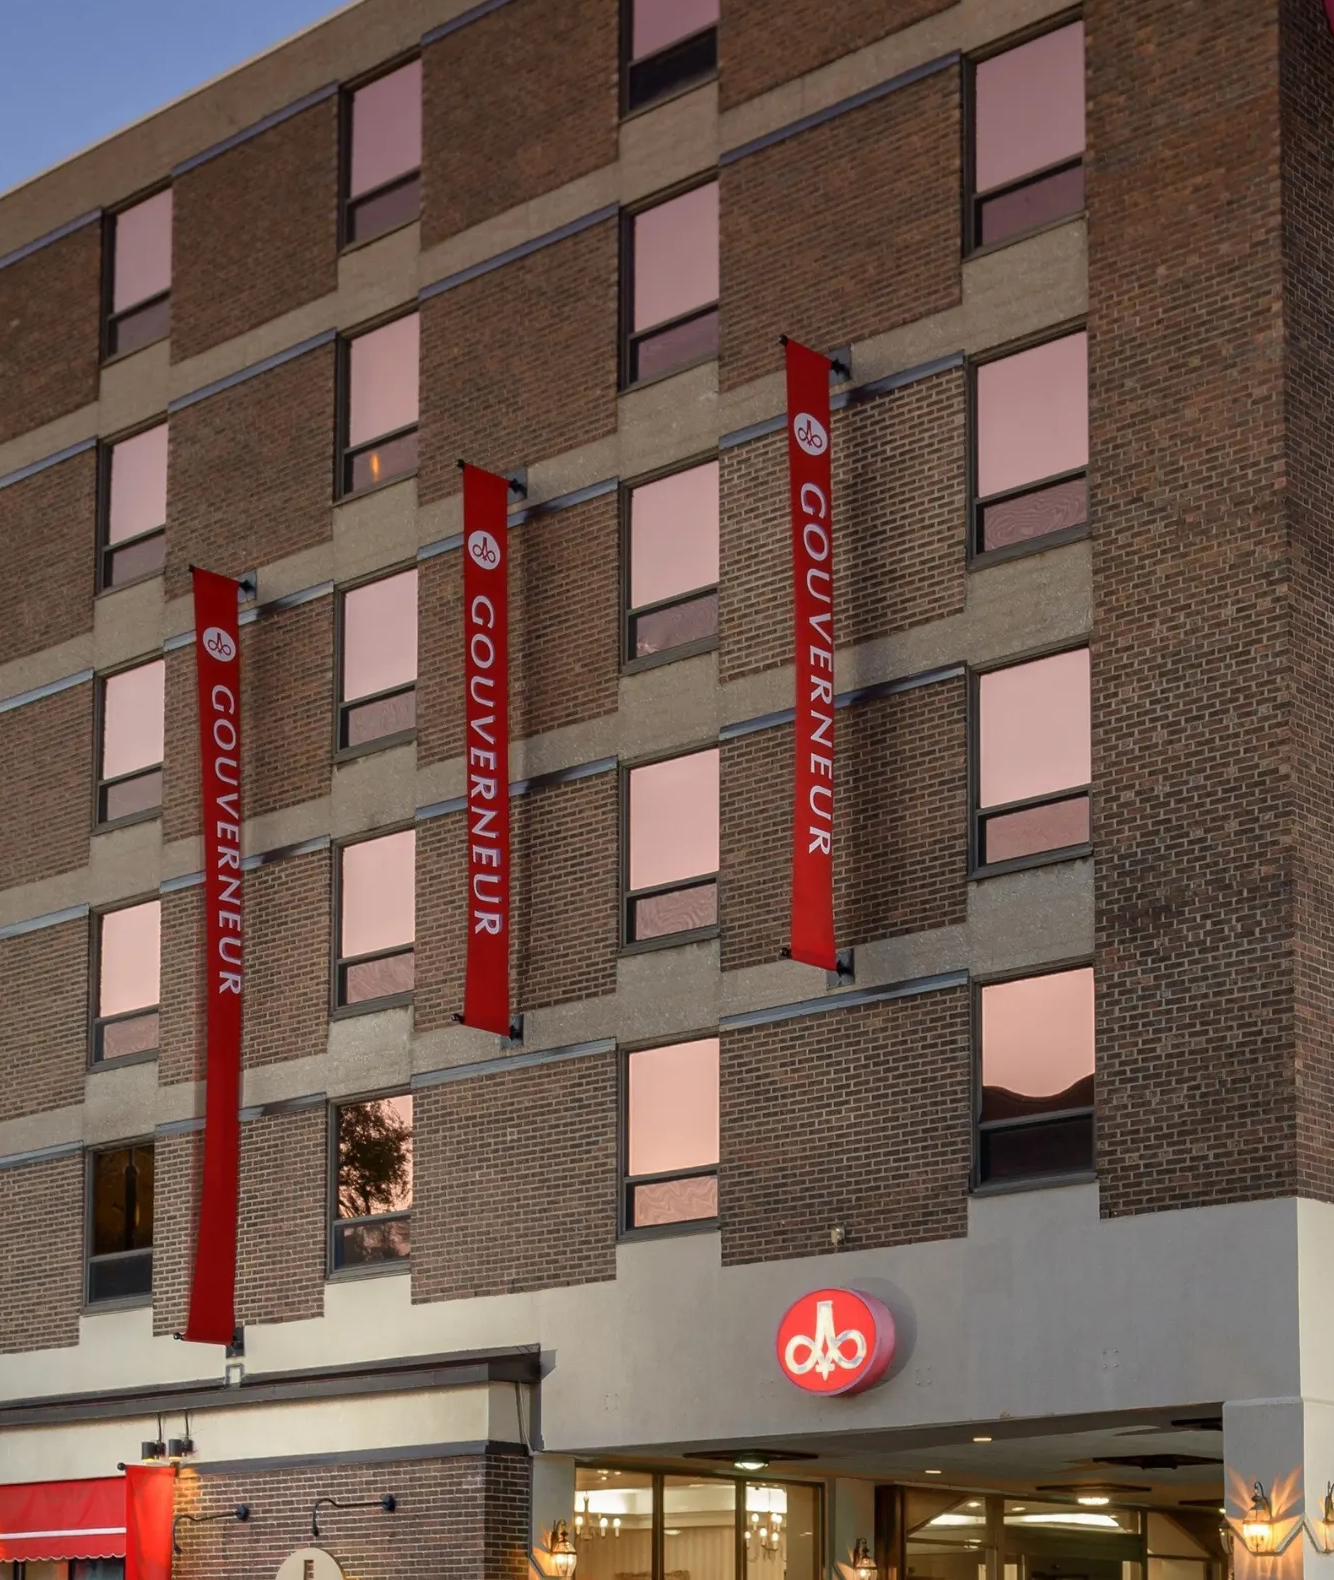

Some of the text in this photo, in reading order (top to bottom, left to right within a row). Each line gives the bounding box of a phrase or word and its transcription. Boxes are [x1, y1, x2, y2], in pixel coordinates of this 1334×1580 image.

[470, 595, 503, 935] GOUVERNEUR
[801, 481, 834, 856] GOUVERNEUR
[210, 684, 242, 996] GOUVERNEUR
